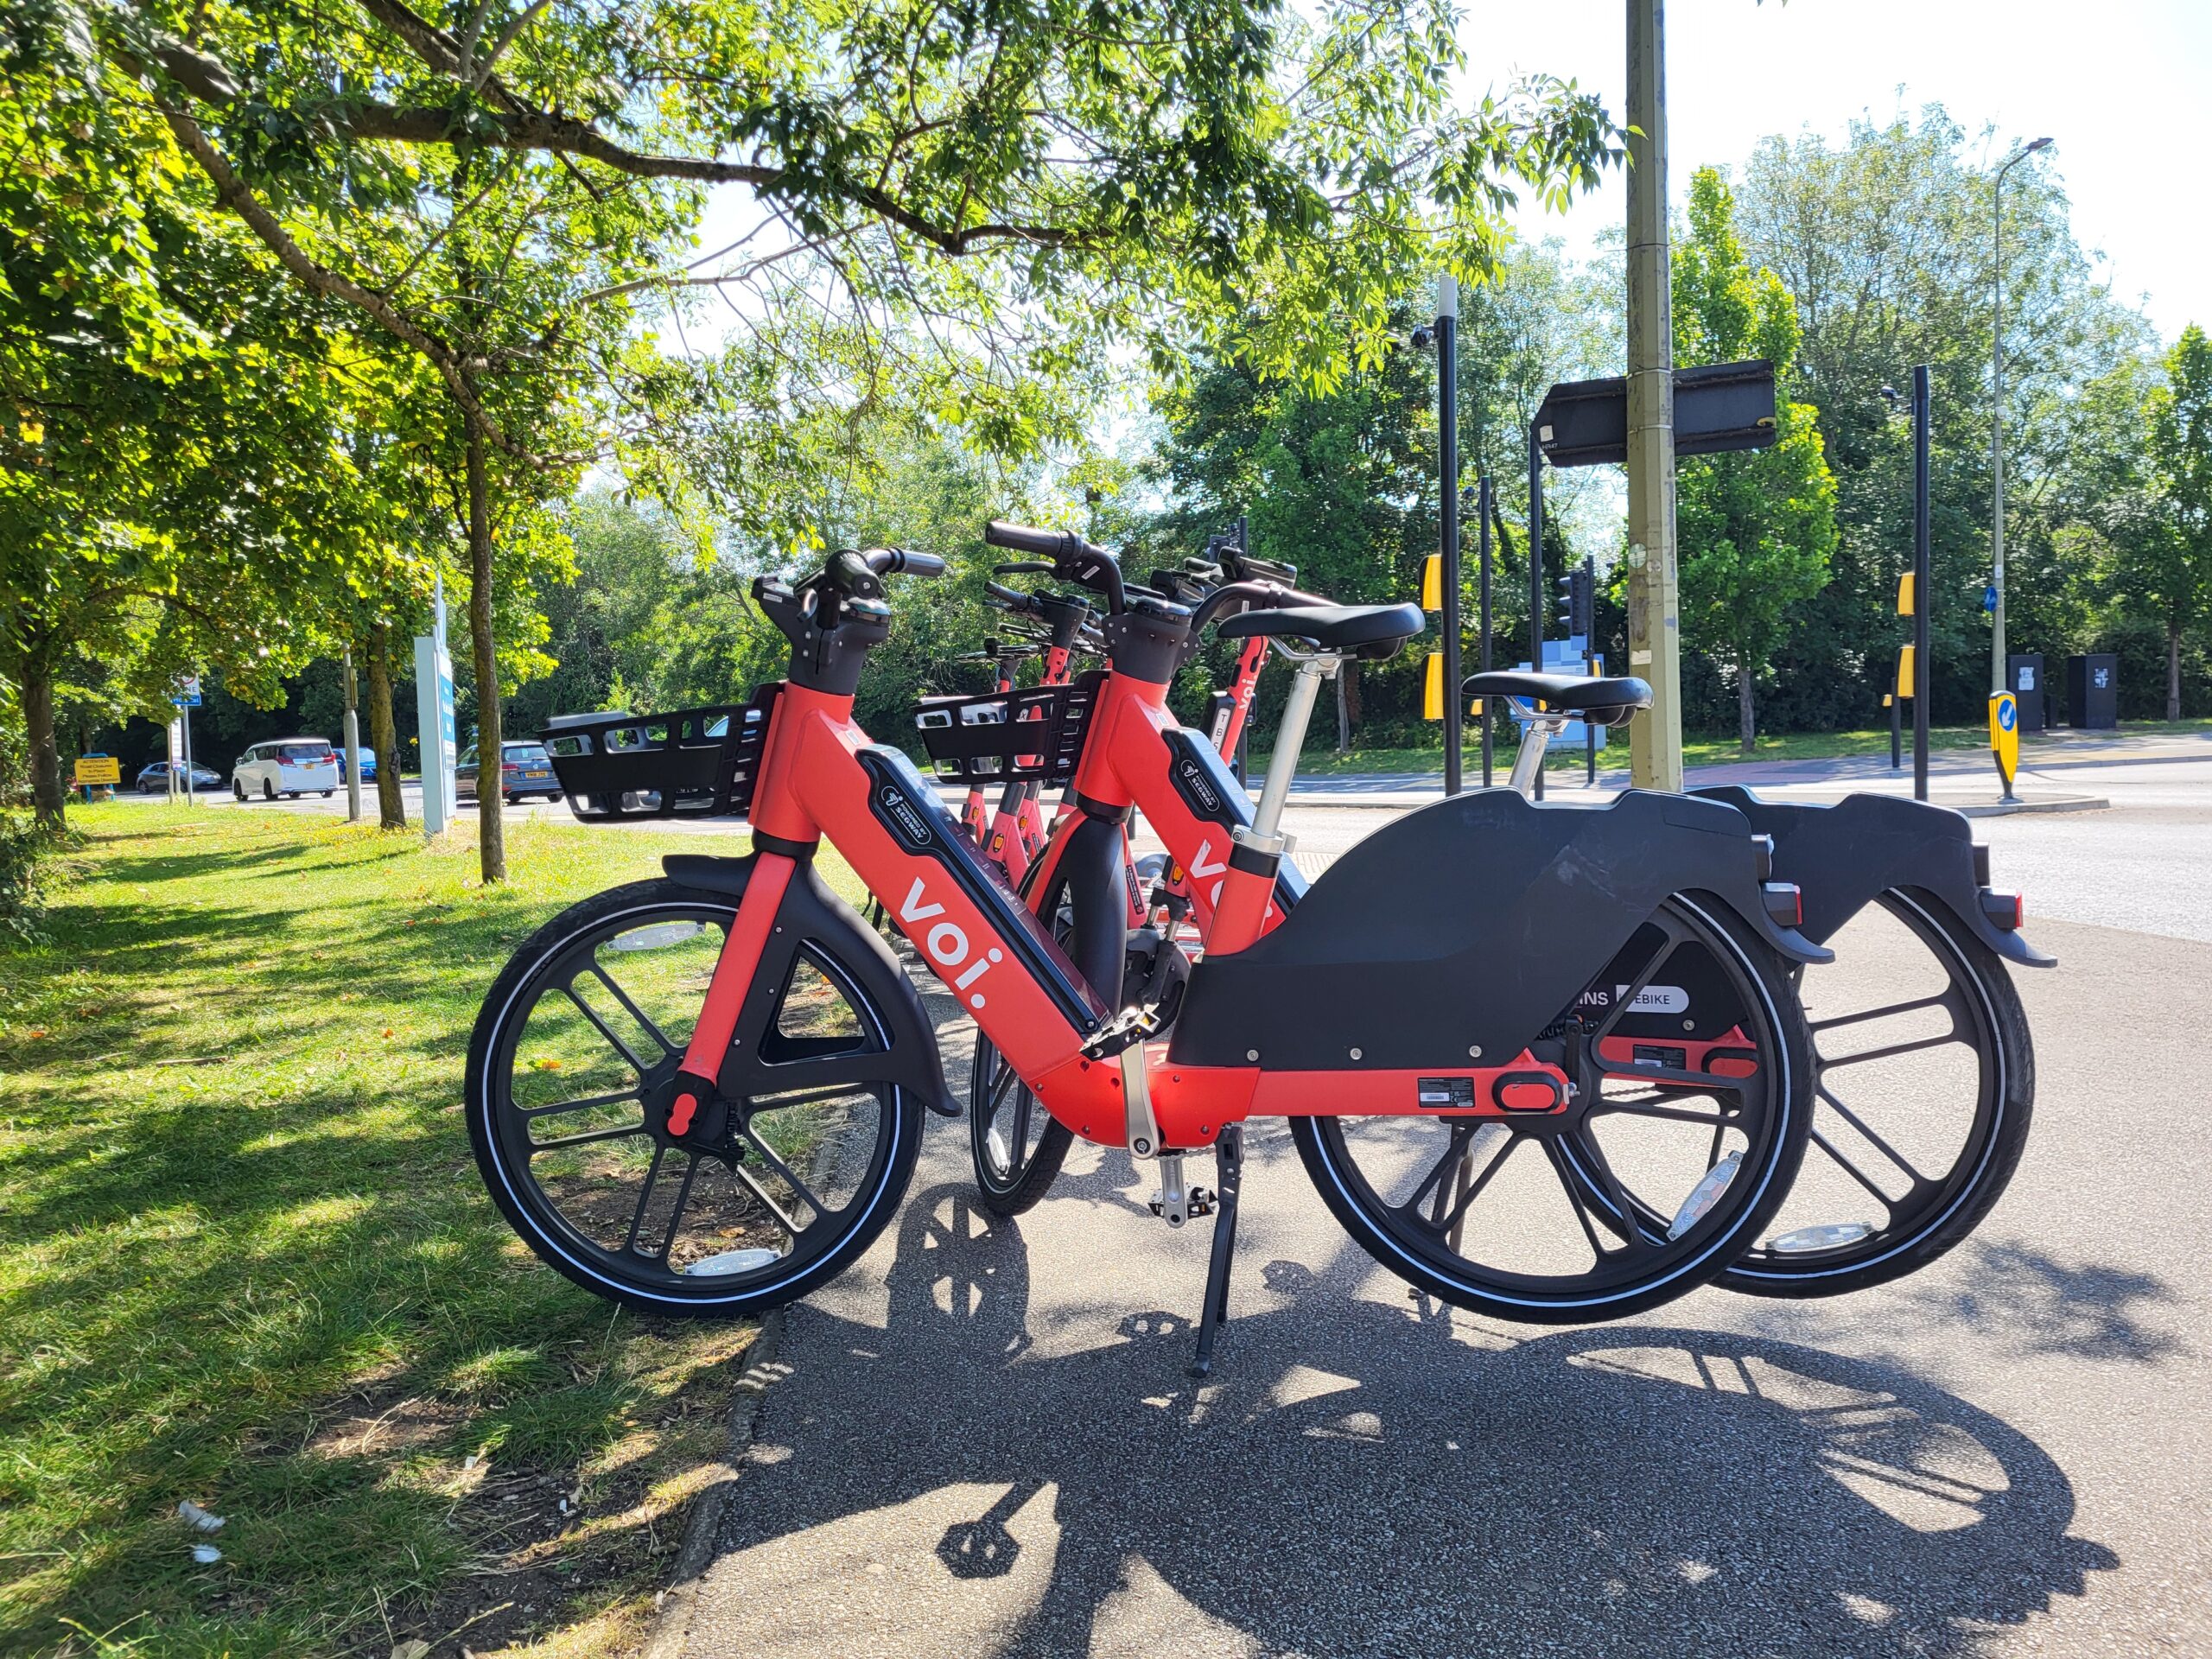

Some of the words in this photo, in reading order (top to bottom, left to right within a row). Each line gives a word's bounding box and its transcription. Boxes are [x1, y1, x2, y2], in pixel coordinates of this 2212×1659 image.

[1192, 778, 1213, 806] SEGWAY
[895, 806, 924, 838] SEGWAY
[900, 803, 921, 828] POWERED
[900, 876, 1002, 1008] voi.
